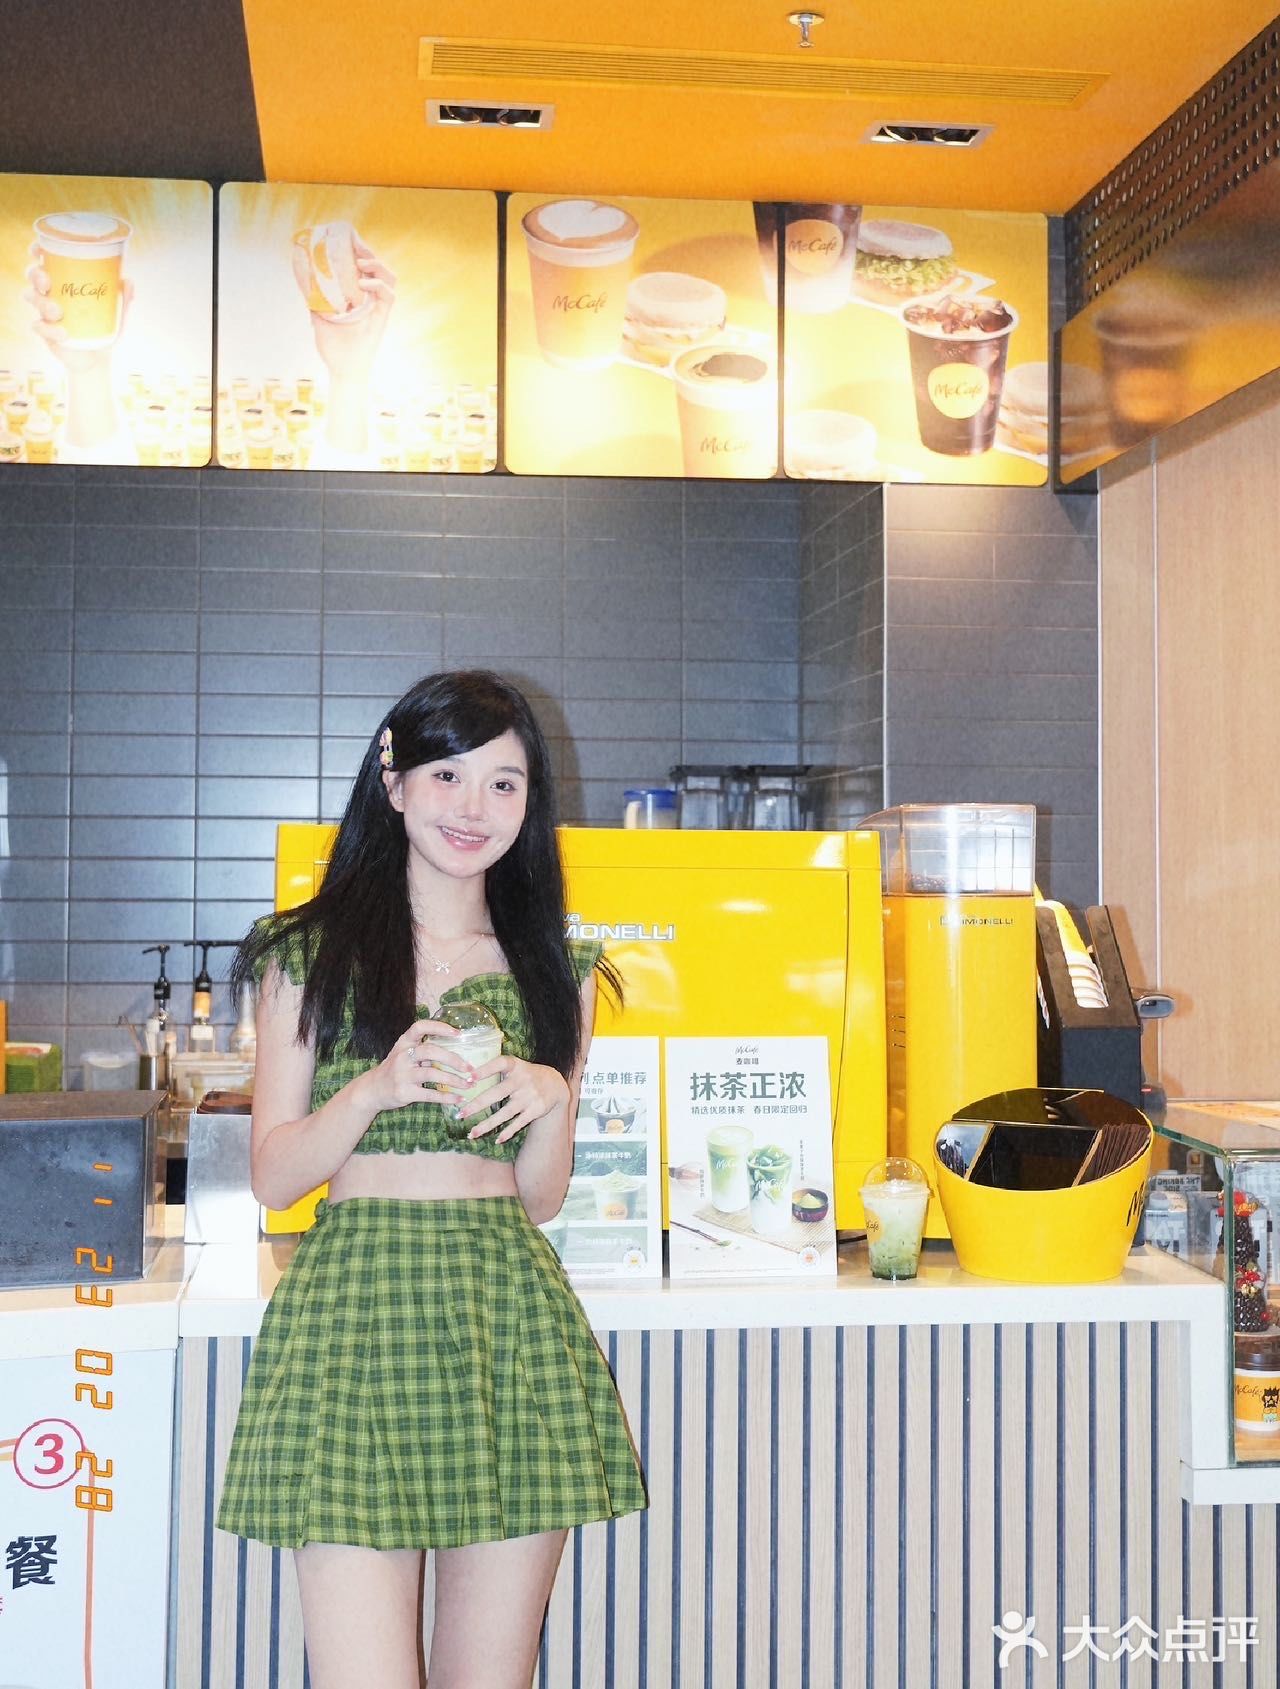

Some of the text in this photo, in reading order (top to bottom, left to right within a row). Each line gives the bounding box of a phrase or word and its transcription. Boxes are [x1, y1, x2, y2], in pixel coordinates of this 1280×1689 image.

[690, 1072, 807, 1101] 抹茶正浓
[33, 1433, 65, 1475] 3
[5, 1534, 59, 1590] 餐
